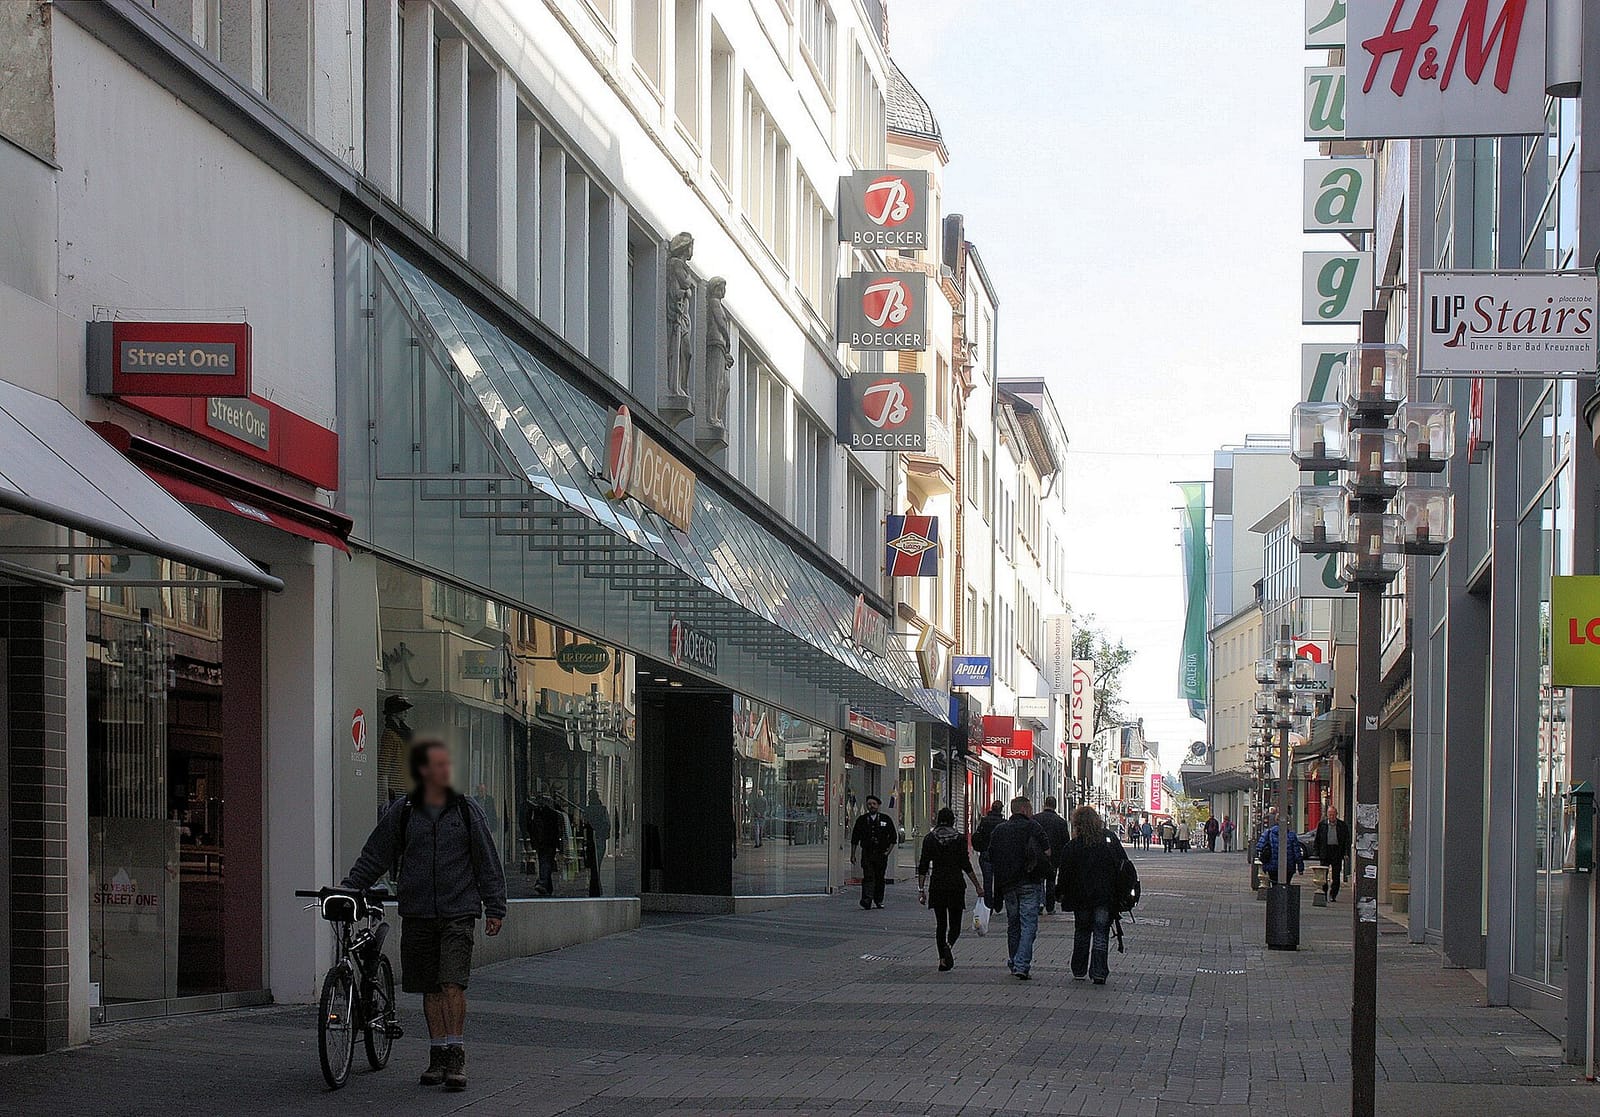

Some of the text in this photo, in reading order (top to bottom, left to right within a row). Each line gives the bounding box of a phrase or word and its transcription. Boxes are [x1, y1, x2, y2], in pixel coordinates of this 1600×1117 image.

[1362, 0, 1526, 96] H&M
[854, 231, 923, 244] BOECKER
[1469, 295, 1593, 334] Stairs
[852, 333, 921, 346] BOECKER
[1470, 341, 1494, 351] Diner
[1506, 341, 1522, 351] Bar
[1525, 341, 1541, 351] Bad
[1544, 342, 1590, 352] Kreuznach
[127, 348, 230, 368] Street One
[211, 397, 266, 440] Street One
[852, 433, 921, 447] BOECKER
[633, 429, 692, 524] BOECKER
[684, 627, 717, 669] BOECKER
[954, 663, 988, 675] APOLLO
[1186, 653, 1197, 687] GALERIA
[1072, 663, 1092, 741] orsay
[985, 736, 1012, 744] ESPRIT
[1151, 778, 1161, 805] ADLER
[94, 892, 158, 906] STREET ONE
